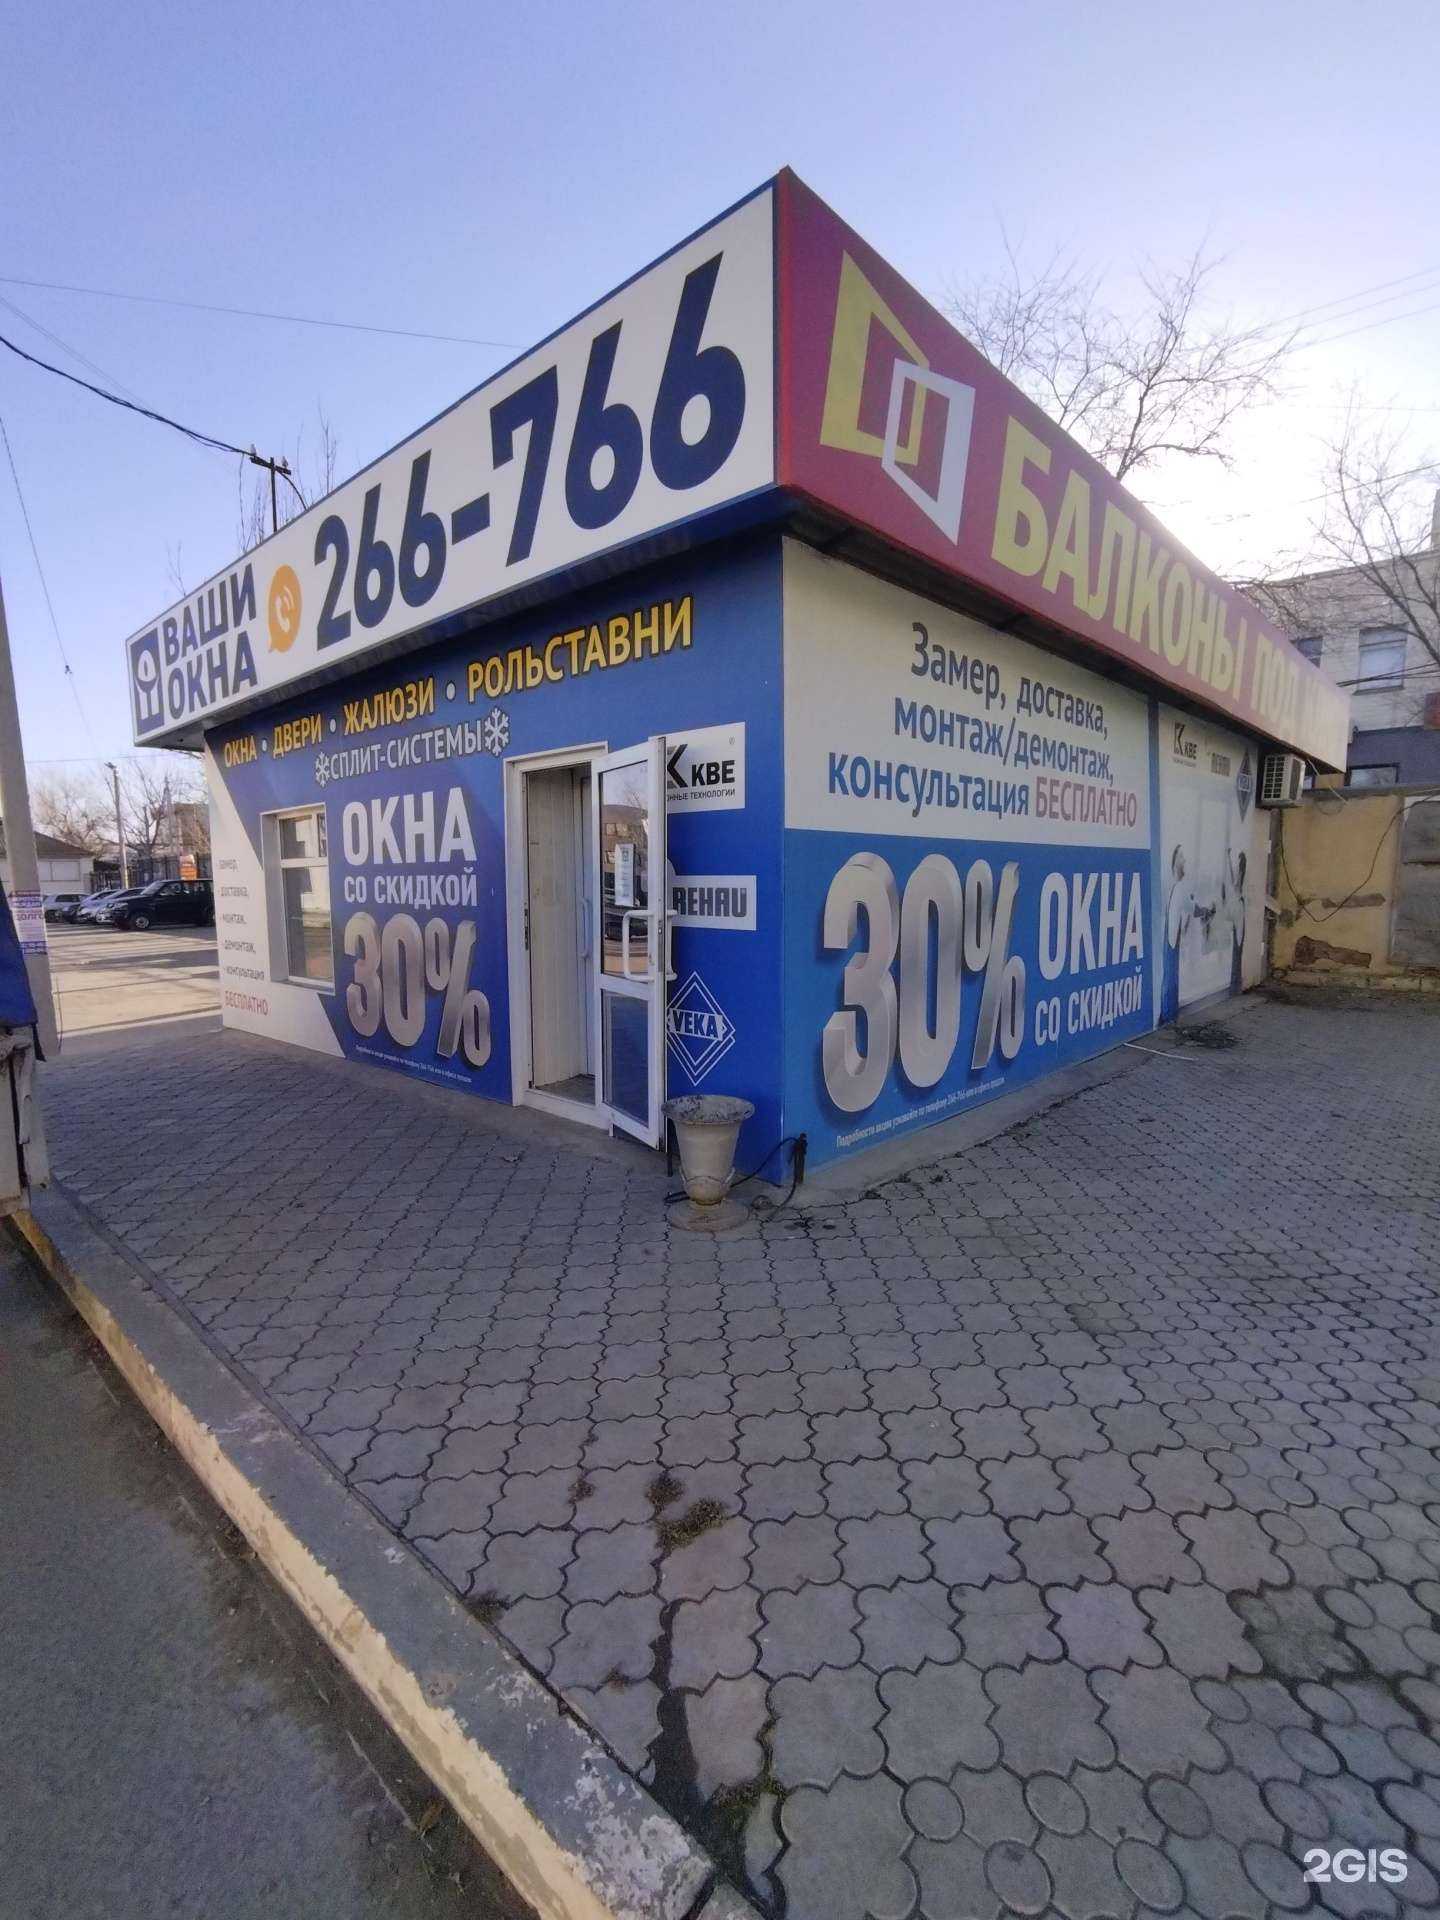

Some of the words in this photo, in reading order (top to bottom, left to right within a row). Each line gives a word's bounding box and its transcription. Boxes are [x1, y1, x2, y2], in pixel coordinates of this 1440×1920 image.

[314, 250, 746, 651] 266-766
[991, 415, 1249, 701] БАЛКОНЫ
[163, 562, 257, 667] ВАШИ
[168, 630, 258, 720] ОКНА
[224, 735, 258, 767] ОКНА
[273, 714, 323, 758] ДВЕРИ
[344, 677, 435, 736] ЖАЛЮЗИ
[467, 595, 693, 704] РОЛЬСТАВНИ
[911, 621, 1006, 711] Замер,
[1016, 676, 1108, 740] доставка,
[329, 719, 482, 781] СПЛИТ-СИСТЕМЫ
[691, 759, 735, 788] KBE
[894, 697, 1114, 787] монтаж/демонтаж,
[342, 786, 478, 867] ОКНА
[690, 788, 736, 800] ТЕХНОЛОГИИ
[828, 751, 1030, 819] консультация
[1035, 776, 1138, 828] БЕСПЛАТНО
[344, 875, 367, 904] СО
[374, 867, 478, 910] СКИДКОЙ
[672, 887, 748, 918] REHAU
[344, 911, 492, 1068] 30%
[672, 1009, 719, 1040] VEKA
[822, 851, 1026, 1113] 30%
[1039, 871, 1144, 981] ОКНА
[1034, 996, 1061, 1046] СО
[1067, 966, 1143, 1035] СКИДКОЙ
